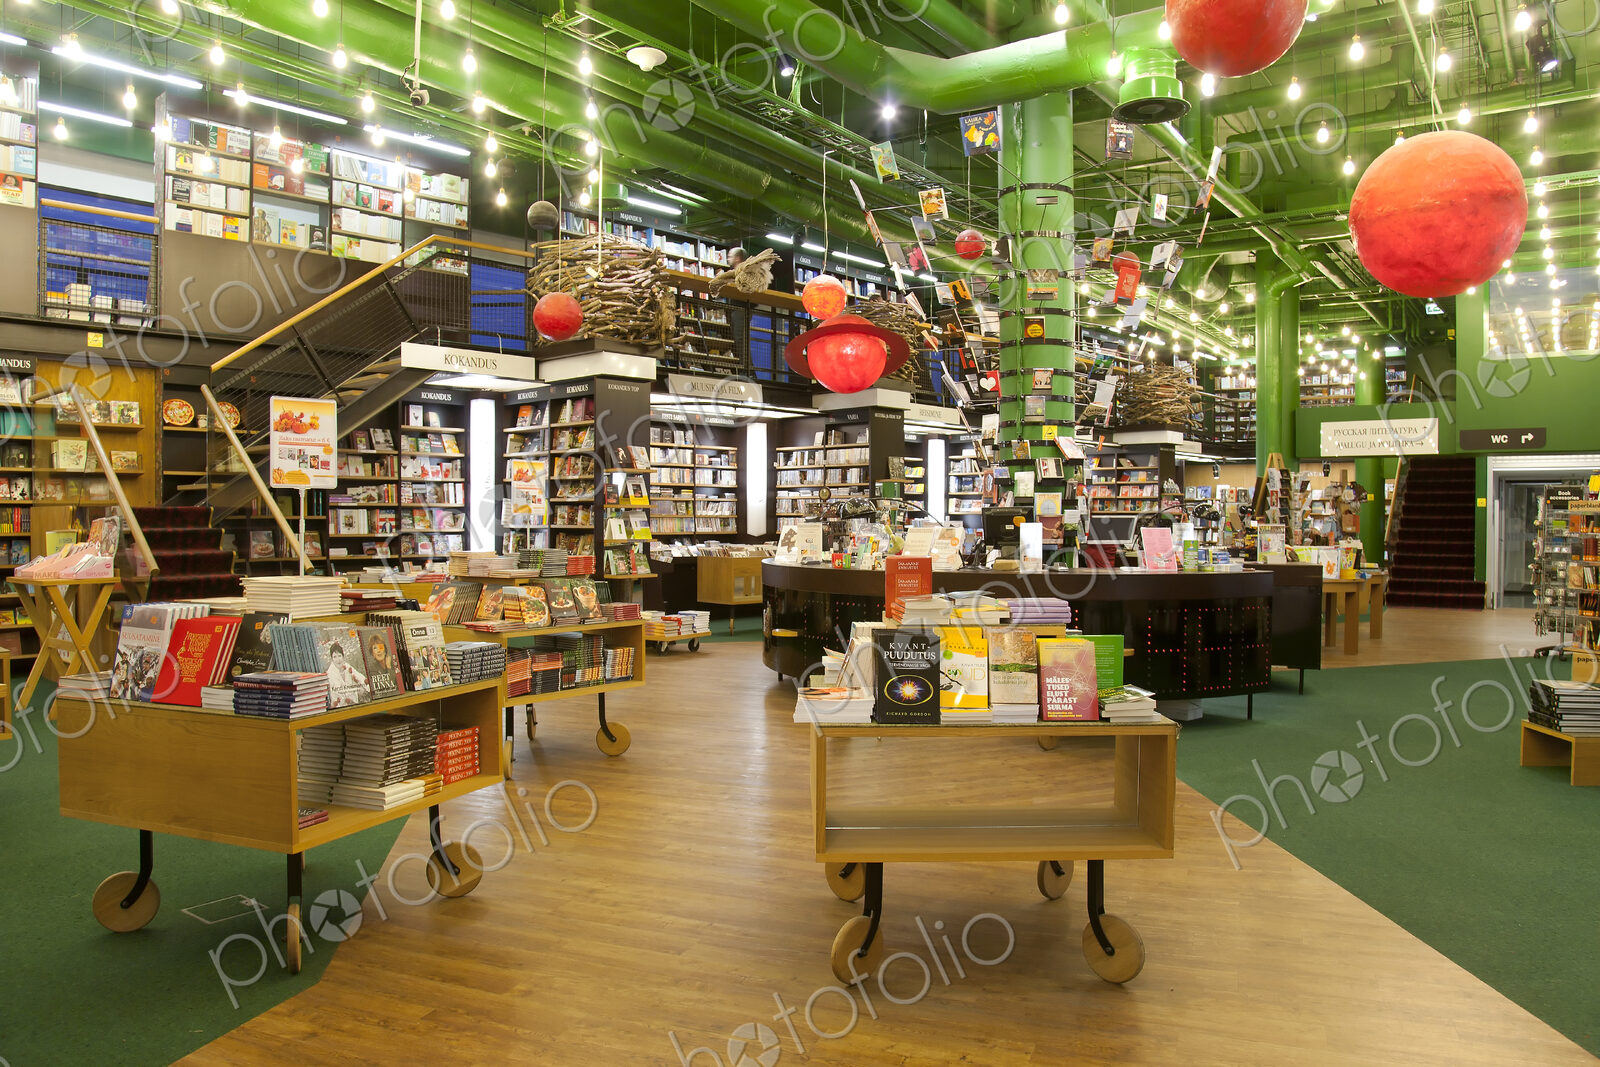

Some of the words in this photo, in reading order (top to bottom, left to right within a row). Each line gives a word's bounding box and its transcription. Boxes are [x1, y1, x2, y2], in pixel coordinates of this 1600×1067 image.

[0, 358, 31, 369] ANDUS
[443, 353, 498, 370] KOKANDUS
[566, 383, 589, 394] KOKANDUS
[607, 383, 630, 392] KOKANDUS
[421, 391, 452, 401] KOKANDUS
[1334, 428, 1367, 436] РУССКАЯ
[1369, 426, 1418, 436] ЛИТЕРАТУРА
[1491, 434, 1509, 444] WC
[883, 651, 936, 660] PUUDUTUS
[372, 672, 391, 682] REET
[1045, 676, 1072, 684] MÄLES-
[372, 680, 395, 690] LINNA
[1046, 696, 1078, 704] PÄRAST
[449, 731, 463, 741] PEKING
[449, 739, 463, 749] PEKING
[448, 748, 463, 757] PEKING
[448, 756, 463, 766] PEKING
[449, 764, 463, 774] PEKING
[450, 772, 464, 782] PEKING
